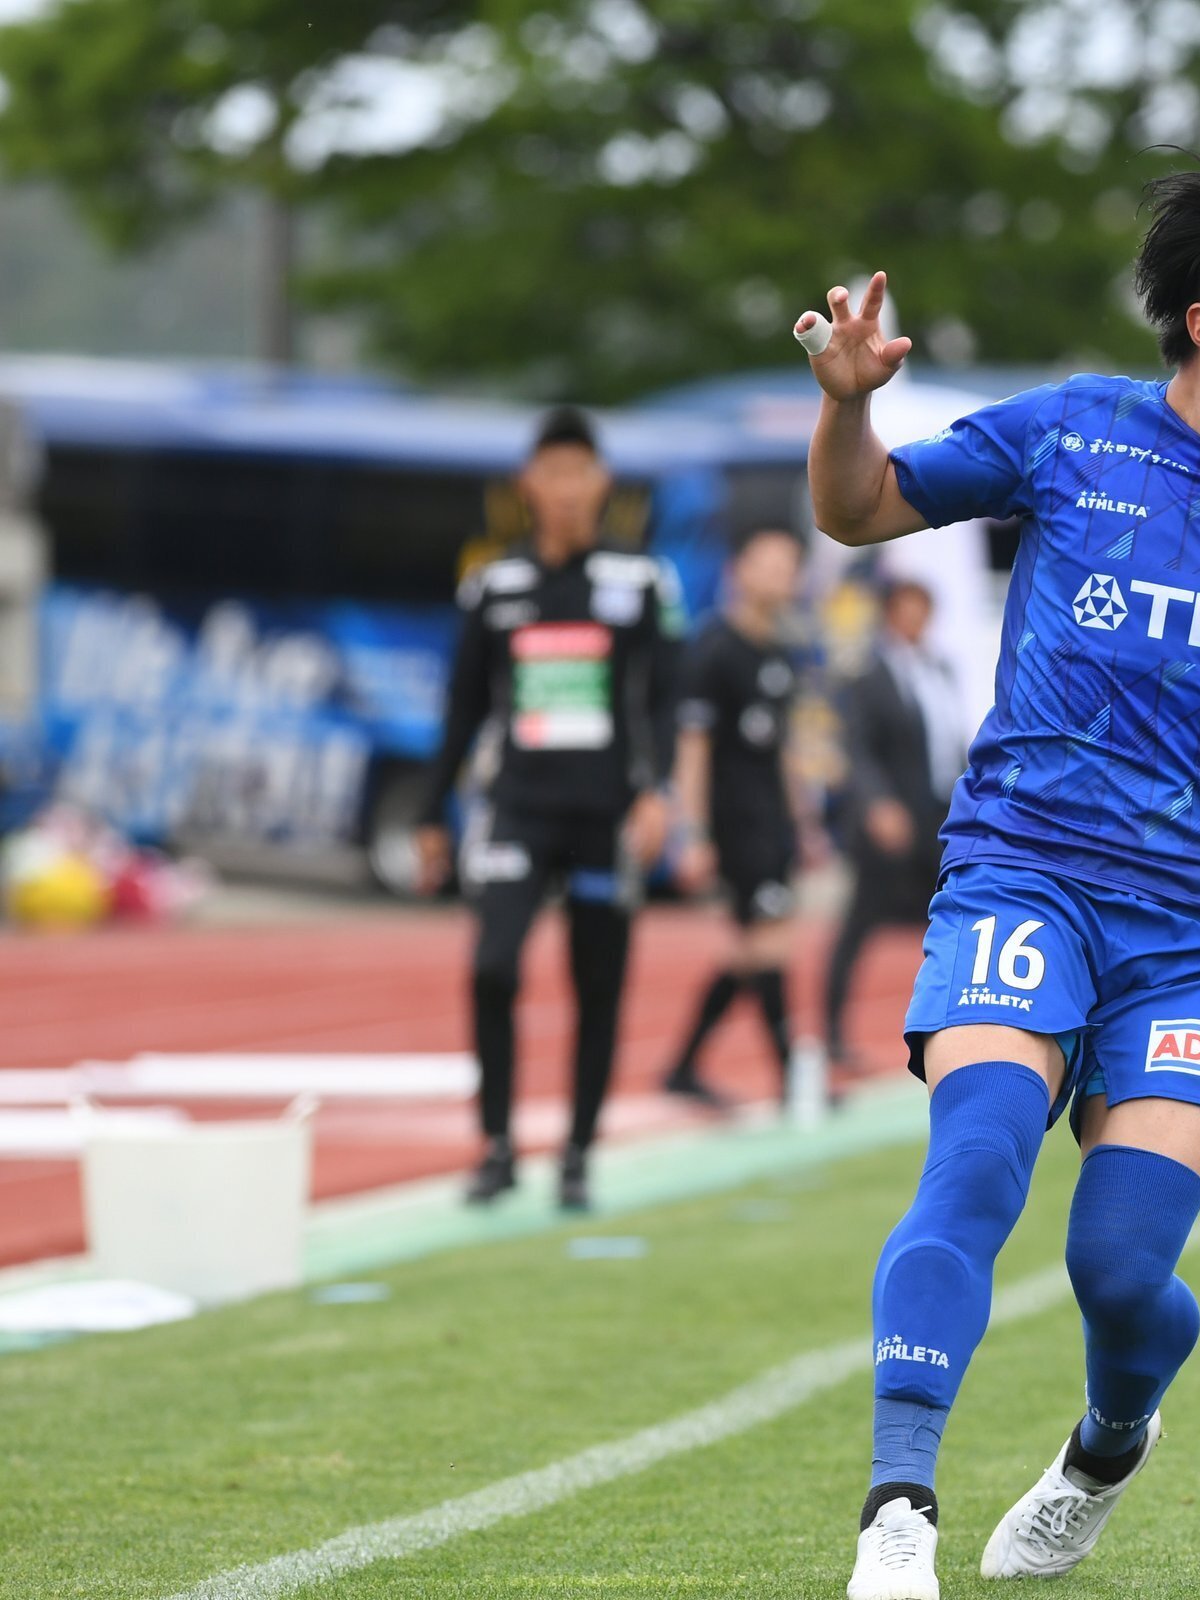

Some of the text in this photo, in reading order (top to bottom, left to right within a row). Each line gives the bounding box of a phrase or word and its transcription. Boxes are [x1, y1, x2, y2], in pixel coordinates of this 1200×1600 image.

[1076, 496, 1148, 518] ATHLETA
[970, 914, 1047, 991] 16
[957, 993, 1031, 1012] ATHLETA
[875, 1343, 950, 1369] ATHLETA
